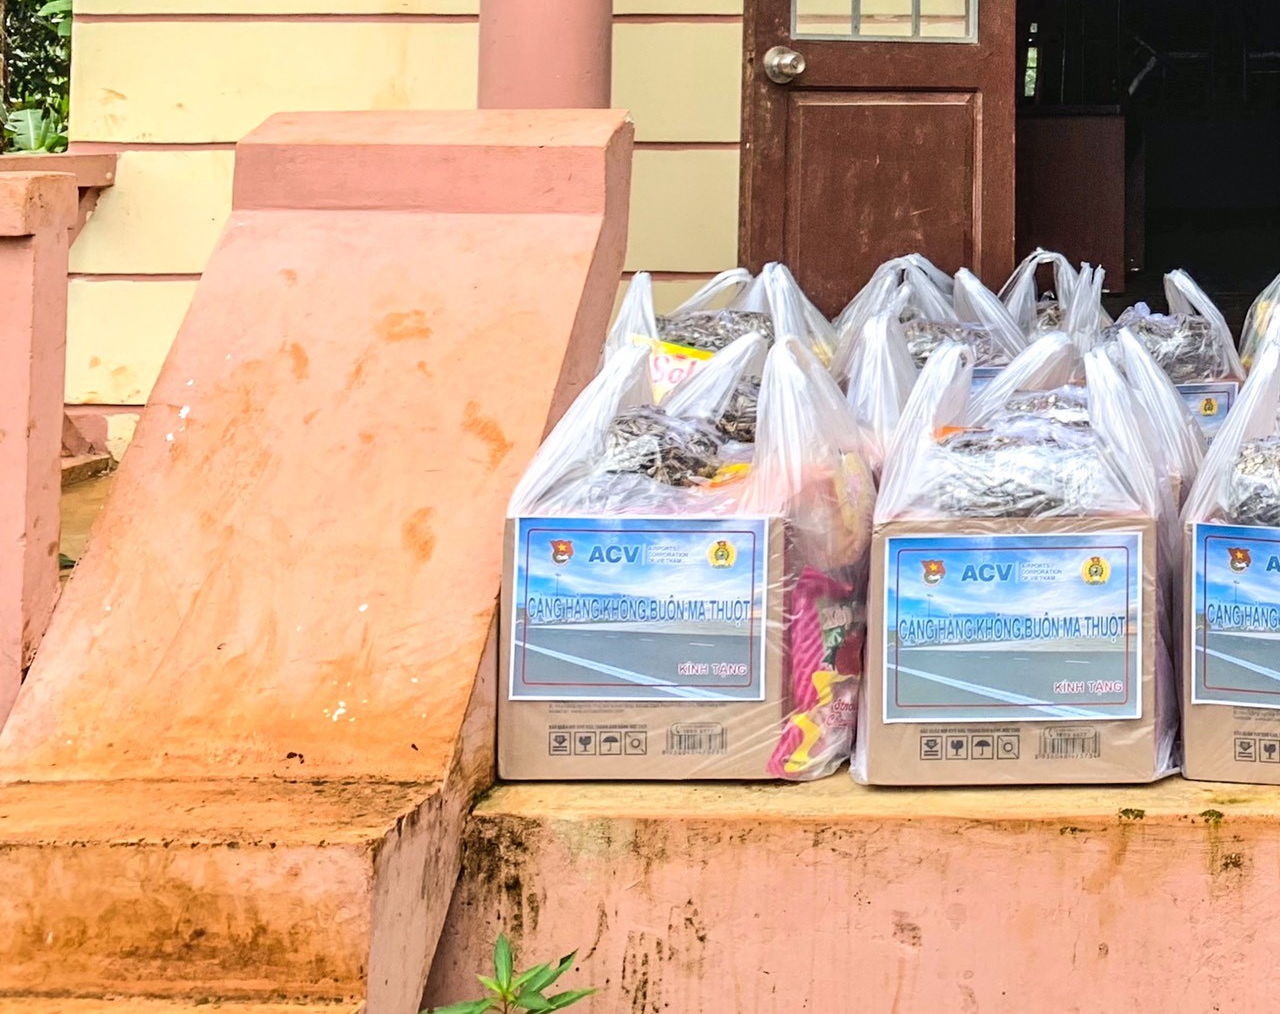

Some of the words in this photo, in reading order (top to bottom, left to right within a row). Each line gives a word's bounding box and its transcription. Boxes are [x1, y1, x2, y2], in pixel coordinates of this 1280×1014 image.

[588, 545, 640, 563] ACV
[961, 564, 1013, 581] ACV
[650, 594, 685, 620] BUÔN
[688, 600, 706, 620] MA
[1025, 612, 1061, 637] BUÔN
[1063, 617, 1081, 636] MA
[678, 661, 708, 675] KÍNH
[1054, 679, 1084, 693] KÍNH
